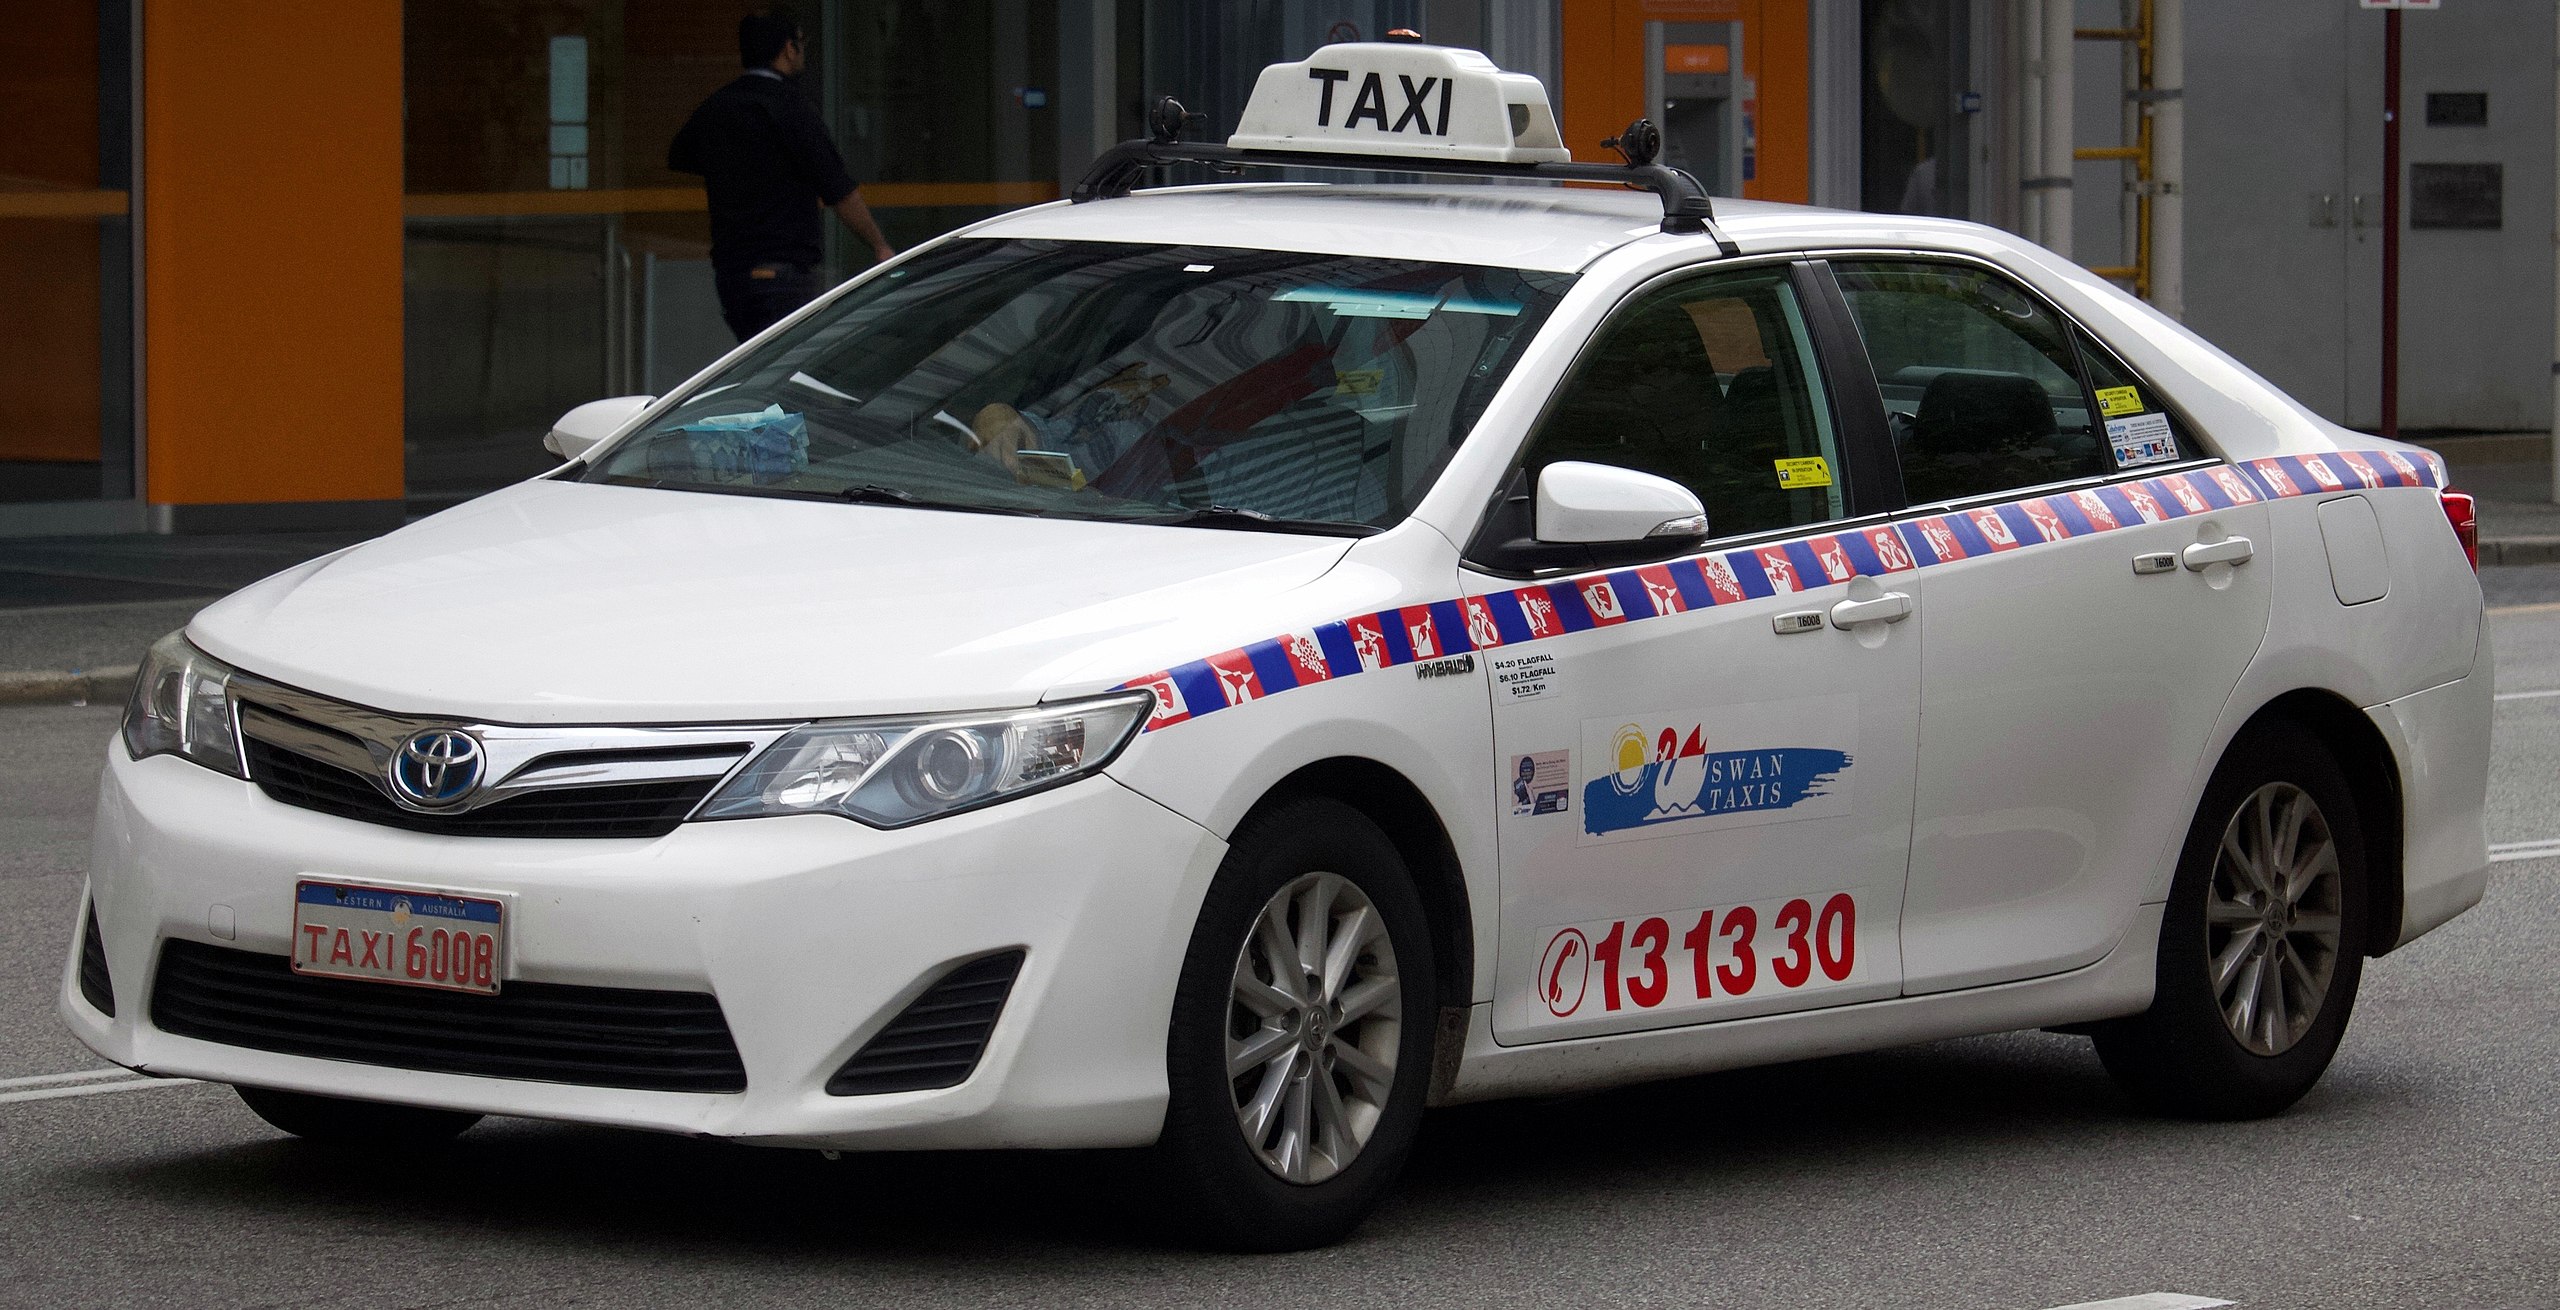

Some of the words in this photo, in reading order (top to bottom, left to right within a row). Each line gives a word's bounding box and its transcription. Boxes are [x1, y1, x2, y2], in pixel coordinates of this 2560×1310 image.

[1309, 68, 1453, 136] TAXI
[1796, 615, 1821, 627] T6008
[1415, 658, 1466, 679] HYBRID
[1495, 660, 1516, 670] $4.20
[1517, 654, 1553, 666] FLAGFALL
[1499, 673, 1518, 683] $6.10
[1520, 667, 1556, 679] FLAGFALL
[1711, 754, 1783, 783] SWAN
[1710, 782, 1781, 811] TAXIS
[336, 898, 382, 908] WESTERN
[422, 904, 467, 918] AUSTRALIA
[303, 924, 395, 971] TAXI
[406, 925, 494, 987] 6008
[1593, 917, 1670, 1012] 13
[1683, 905, 1757, 1000] 13
[1771, 892, 1856, 988] 30
